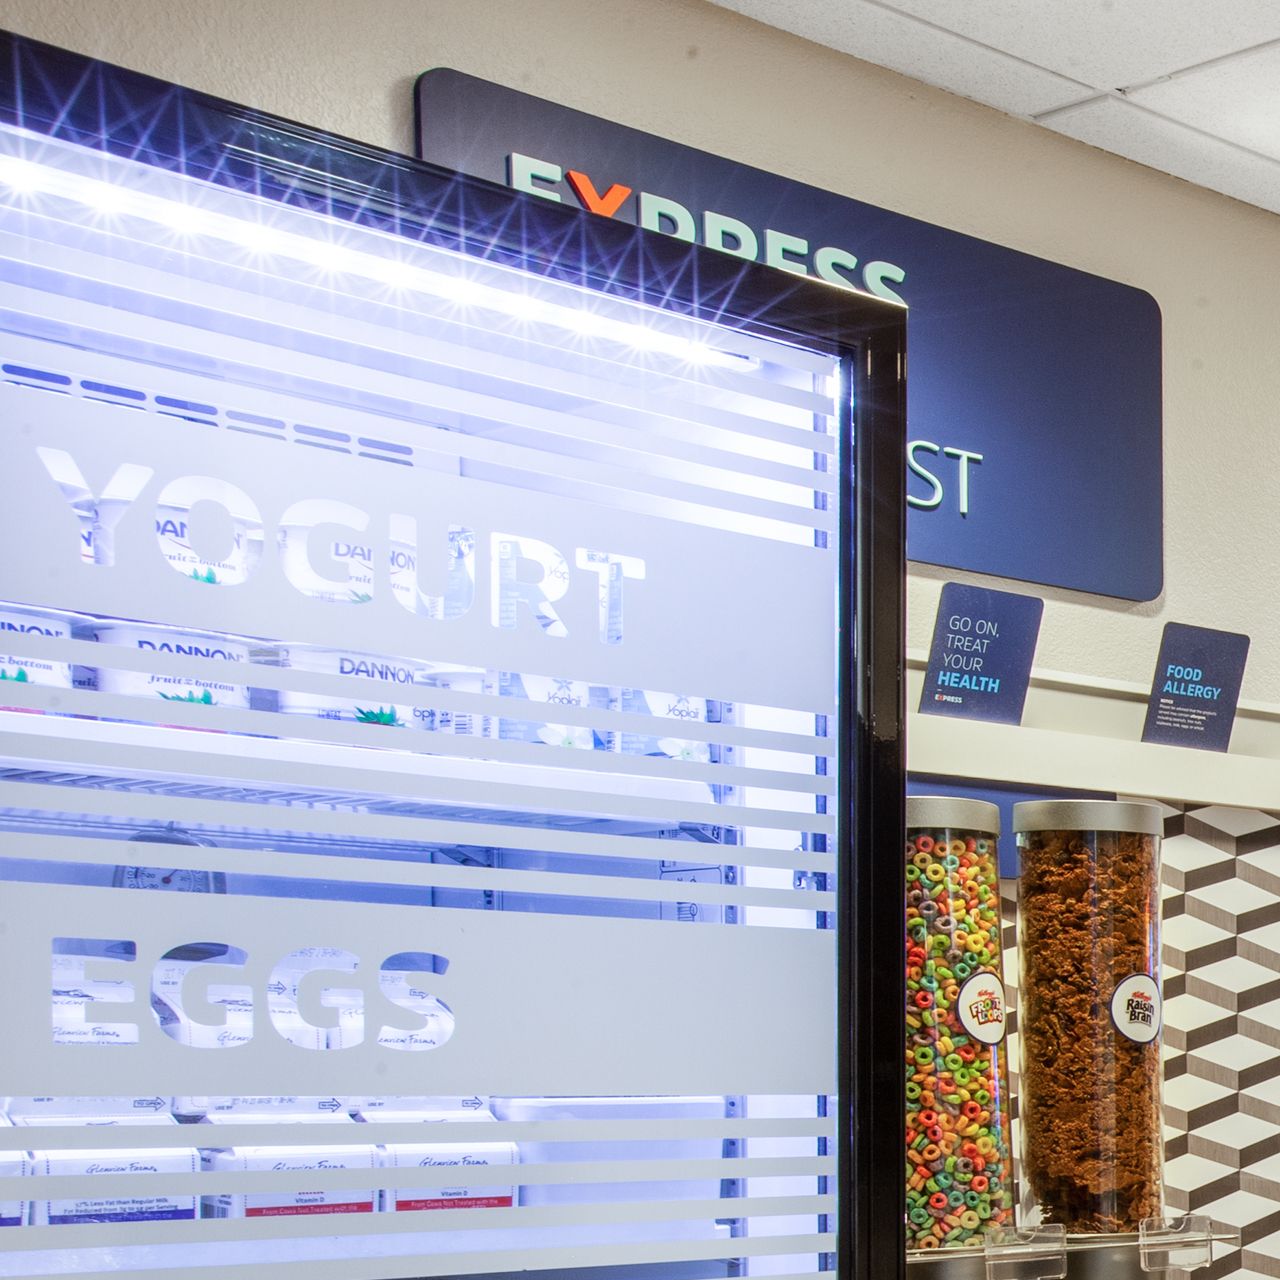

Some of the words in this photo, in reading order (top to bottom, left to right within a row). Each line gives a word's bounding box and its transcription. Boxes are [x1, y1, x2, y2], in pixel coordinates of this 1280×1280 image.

[37, 446, 645, 645] YOGURT
[949, 615, 971, 631] GO
[975, 619, 1000, 639] ON,
[946, 634, 990, 654] TREAT
[339, 657, 416, 685] DANNON
[942, 653, 984, 672] YOUR
[1166, 664, 1202, 681] FOOD
[937, 671, 1000, 693] HEALTH
[1163, 680, 1221, 700] ALLERGY
[52, 937, 455, 1051] EGGS
[1126, 998, 1154, 1015] Raisin
[1129, 1010, 1151, 1024] Bran
